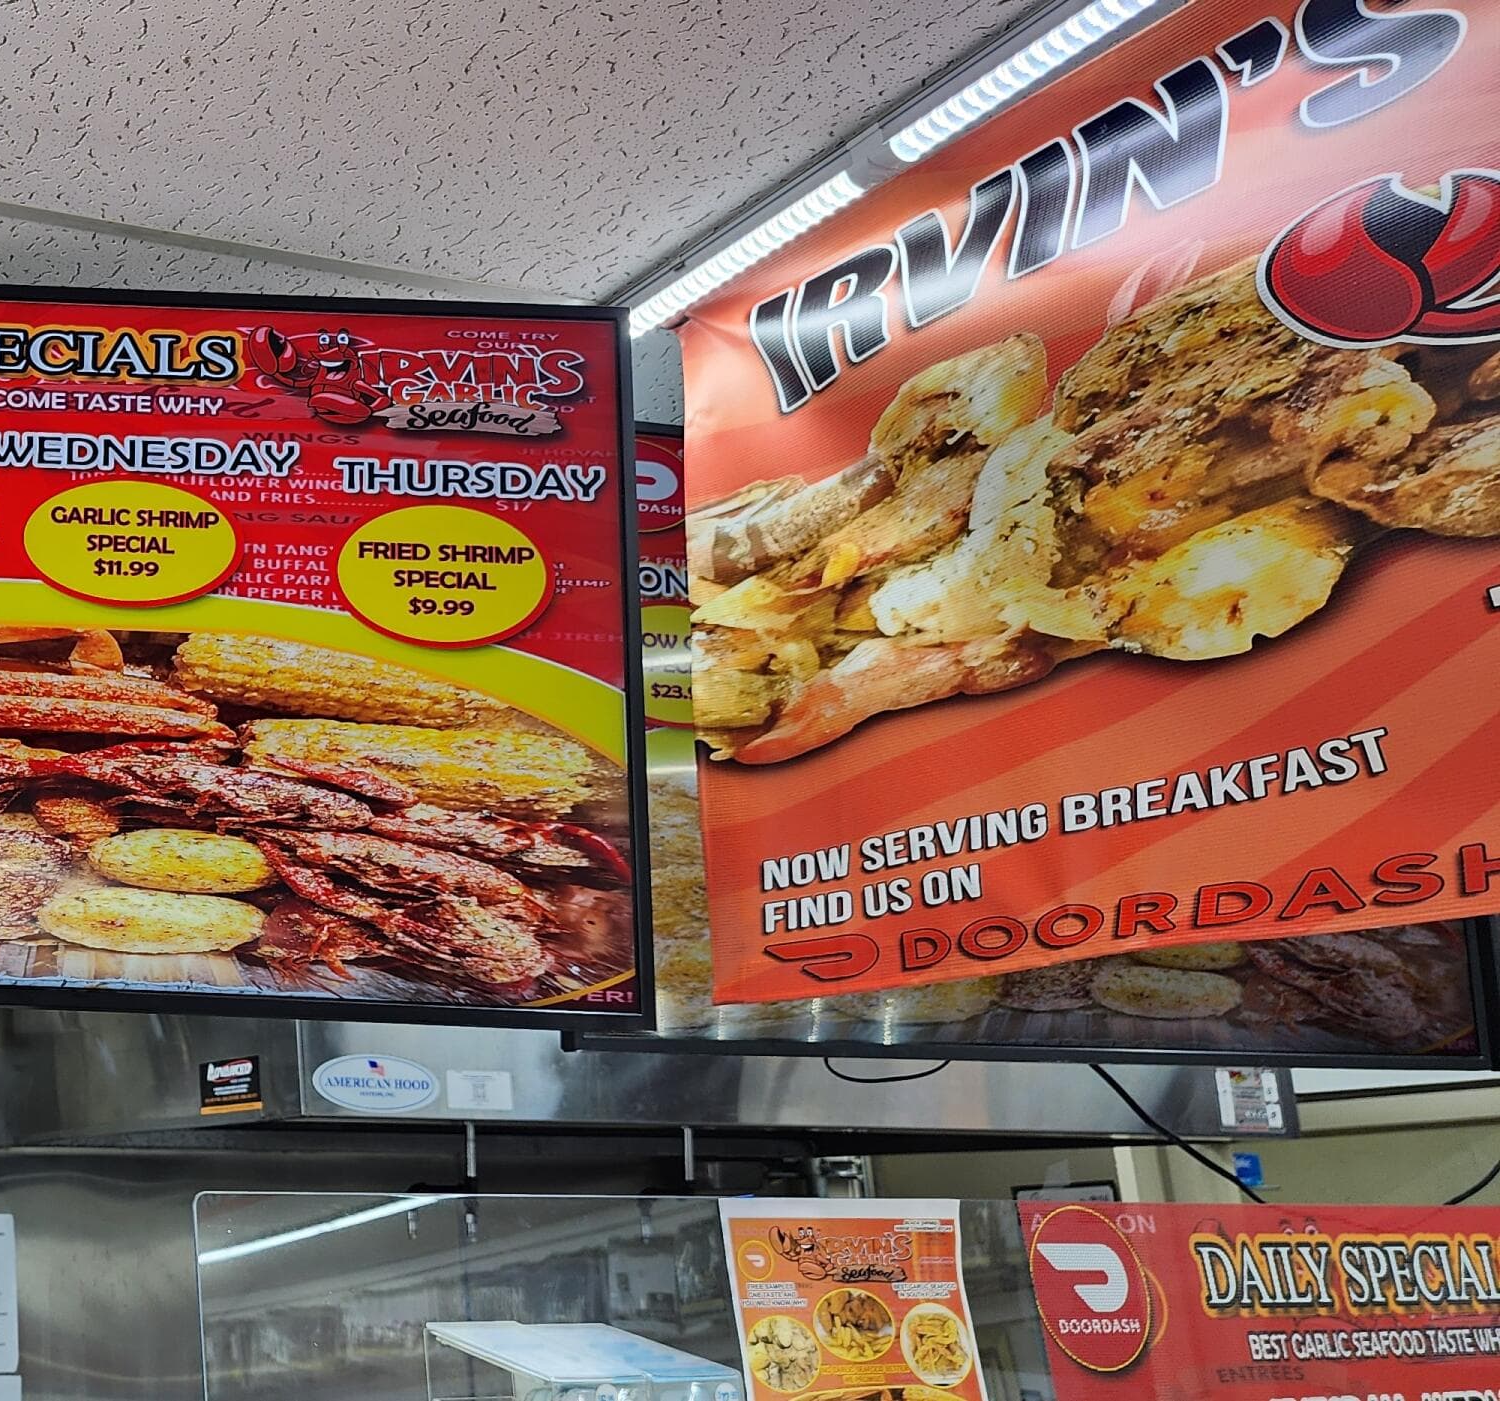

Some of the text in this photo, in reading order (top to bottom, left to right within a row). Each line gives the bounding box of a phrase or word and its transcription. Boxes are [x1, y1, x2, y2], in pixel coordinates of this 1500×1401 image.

[747, 0, 1470, 416] IRVIN'S
[446, 329, 560, 342] COME TRY
[358, 344, 586, 397] IRVIN'S
[72, 392, 154, 414] TASTE
[158, 396, 224, 417] WHY
[390, 378, 548, 412] GARLIC
[406, 401, 536, 435] Seafood
[288, 478, 344, 491] WING
[333, 455, 607, 501] THURSDAY
[260, 491, 317, 505] FRIES
[50, 505, 132, 527] GARLIC
[136, 508, 220, 530] SHRIMP
[86, 534, 176, 555] SPECIAL
[275, 543, 334, 557] TANG
[357, 541, 536, 566] FRIED SHRIMP
[93, 558, 160, 578] $11.99
[252, 558, 329, 572] BUFFAL
[392, 568, 497, 592] SPECIAL
[246, 586, 321, 601] PEPPER
[407, 596, 475, 617] $9.99
[759, 726, 1390, 894] NOW SERVING BREAKFAST
[761, 863, 984, 936] FIND US ON
[900, 842, 1500, 971] DOORDASH
[324, 1075, 431, 1091] AMERICAN HOOD
[1194, 1240, 1500, 1309] DAILY SPECIAL
[1058, 1318, 1141, 1335] DOORDASH
[1248, 1327, 1476, 1362] BEST GARLIC SEAFOOD TASTE
